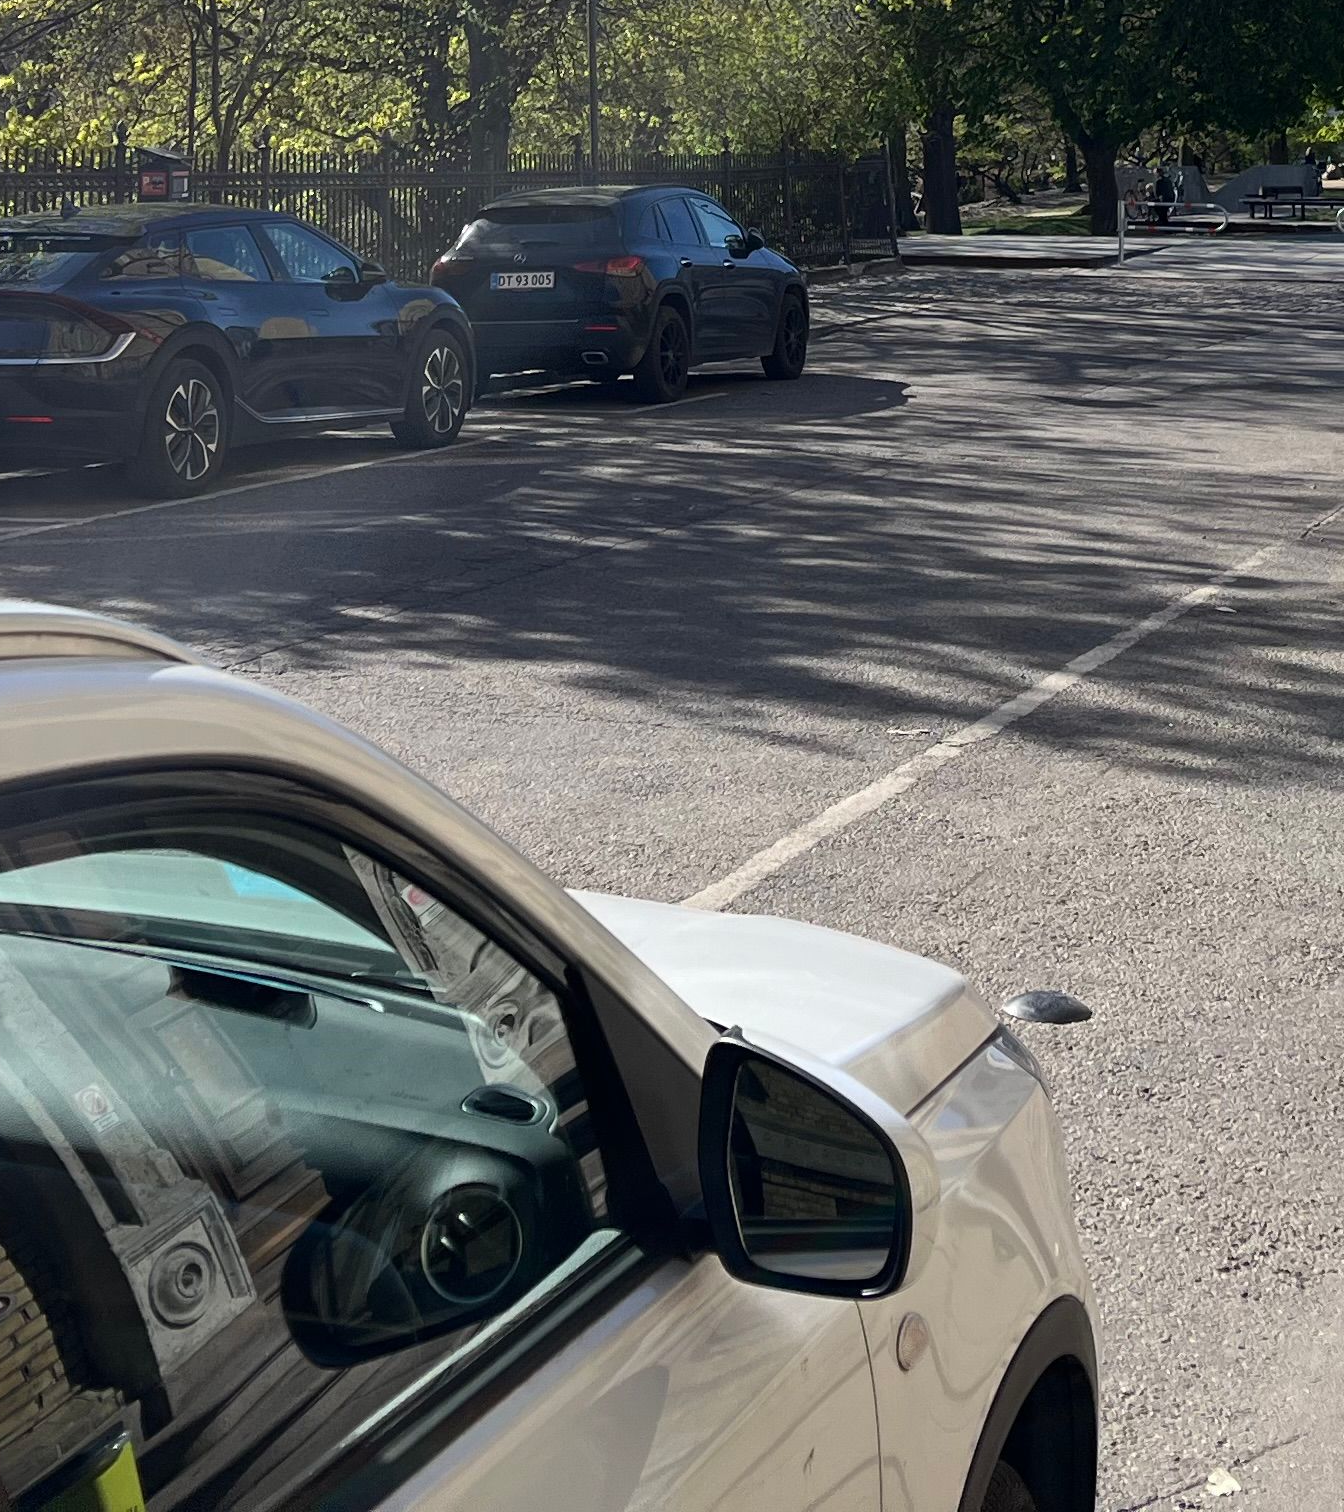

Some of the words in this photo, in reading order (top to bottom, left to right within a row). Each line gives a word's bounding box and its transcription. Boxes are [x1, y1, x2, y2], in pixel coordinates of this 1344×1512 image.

[498, 275, 513, 287] DT
[515, 275, 529, 286] 93
[531, 274, 552, 286] 005
